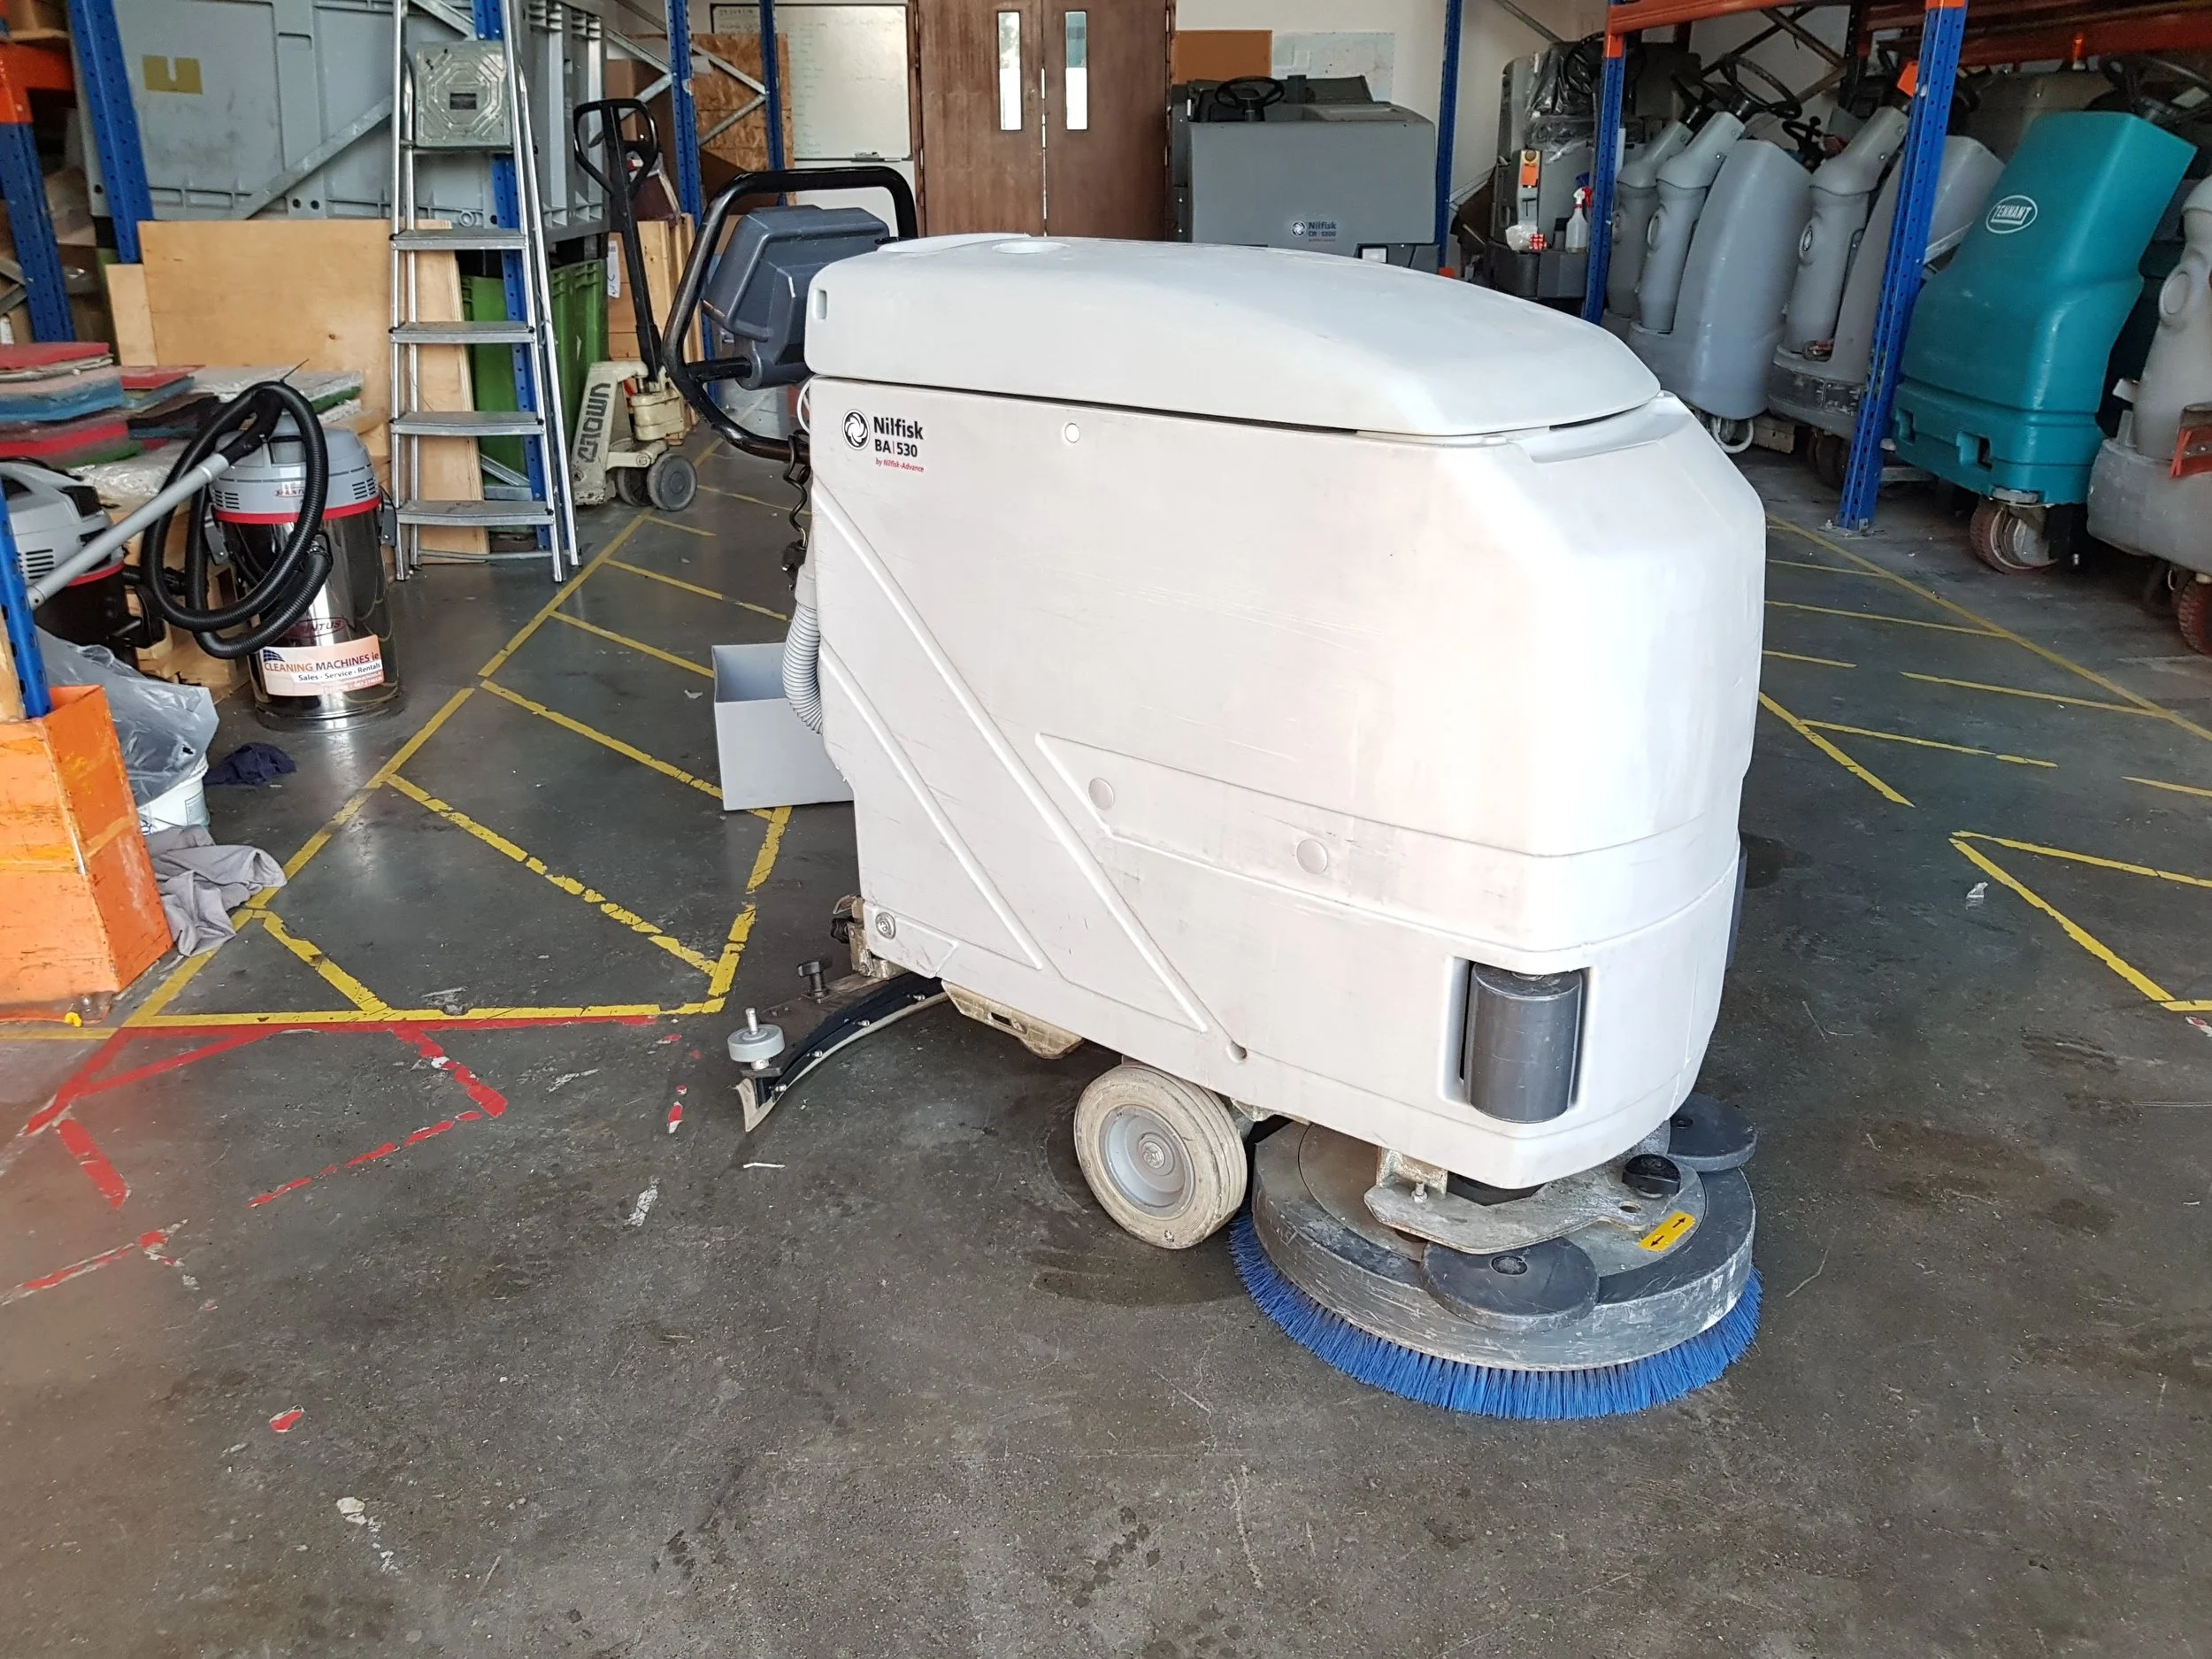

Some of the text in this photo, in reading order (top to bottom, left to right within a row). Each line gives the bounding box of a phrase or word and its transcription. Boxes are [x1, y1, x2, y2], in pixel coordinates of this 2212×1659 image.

[577, 382, 611, 464] CROWN
[873, 416, 924, 440] Nilfisk
[875, 457, 925, 472] by Nilfisk-Advance
[264, 662, 313, 672] CLEANING
[325, 670, 353, 680] Service
[357, 662, 381, 674] Rentals
